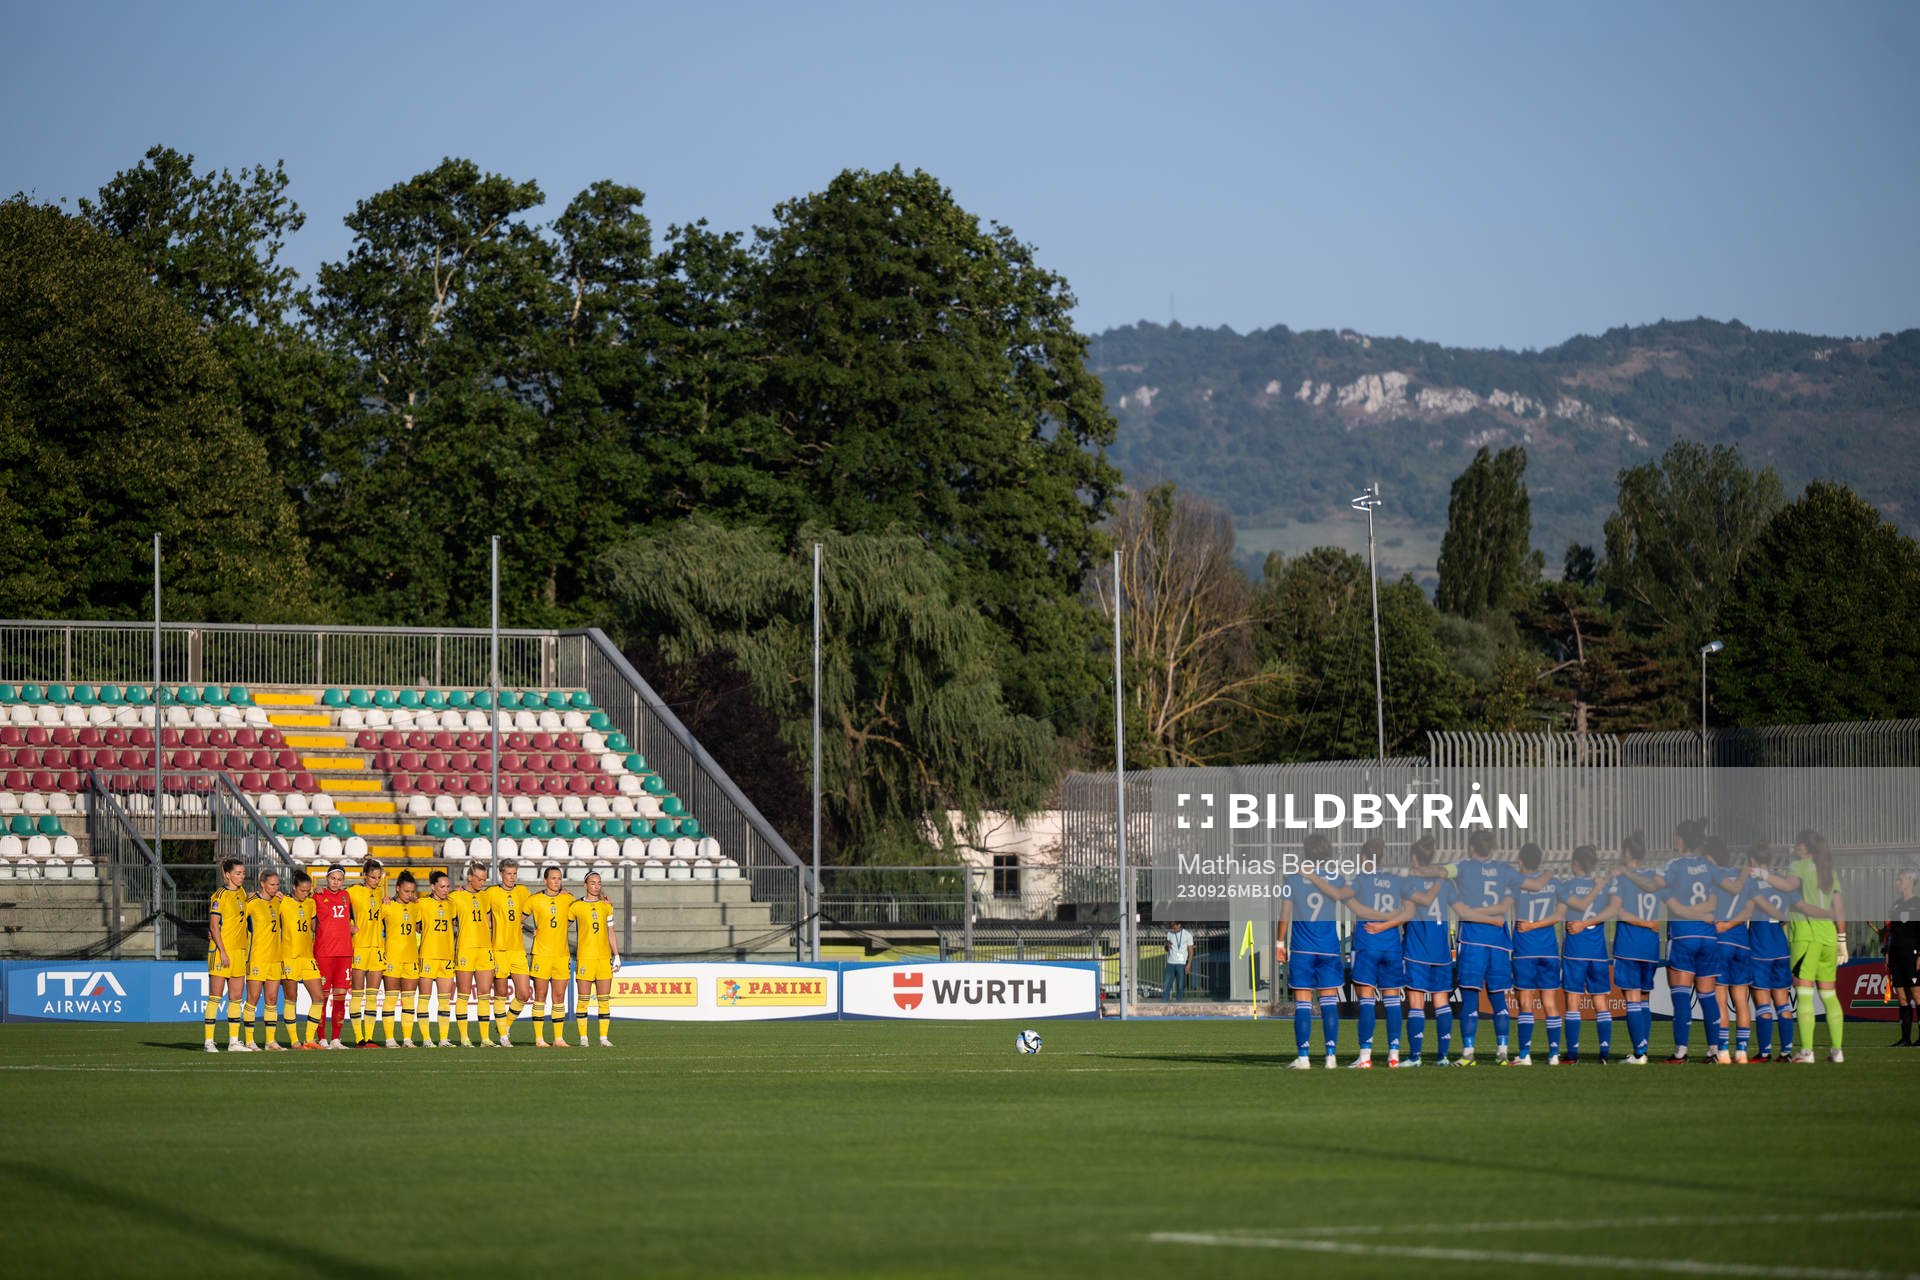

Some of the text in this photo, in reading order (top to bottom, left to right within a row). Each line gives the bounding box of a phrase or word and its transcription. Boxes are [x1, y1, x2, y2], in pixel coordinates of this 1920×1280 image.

[1482, 881, 1499, 907] 5
[1690, 882, 1707, 906] 8
[1307, 892, 1324, 922] 9
[1373, 893, 1395, 913] 18
[1637, 893, 1656, 921] 19
[332, 905, 345, 918] 12
[368, 908, 379, 920] 14
[472, 909, 482, 922] 11
[507, 909, 516, 922] 8
[1428, 897, 1442, 925] 4
[1529, 898, 1551, 922] 17
[271, 920, 277, 932] 2
[297, 920, 308, 932] 16
[434, 919, 448, 932] 23
[550, 916, 557, 928] 6
[592, 922, 600, 934] 9
[400, 923, 412, 935] 19
[37, 971, 127, 996] ITA
[618, 982, 692, 994] PANINI
[748, 982, 822, 994] PANINI
[43, 1001, 122, 1013] AIRWAYS
